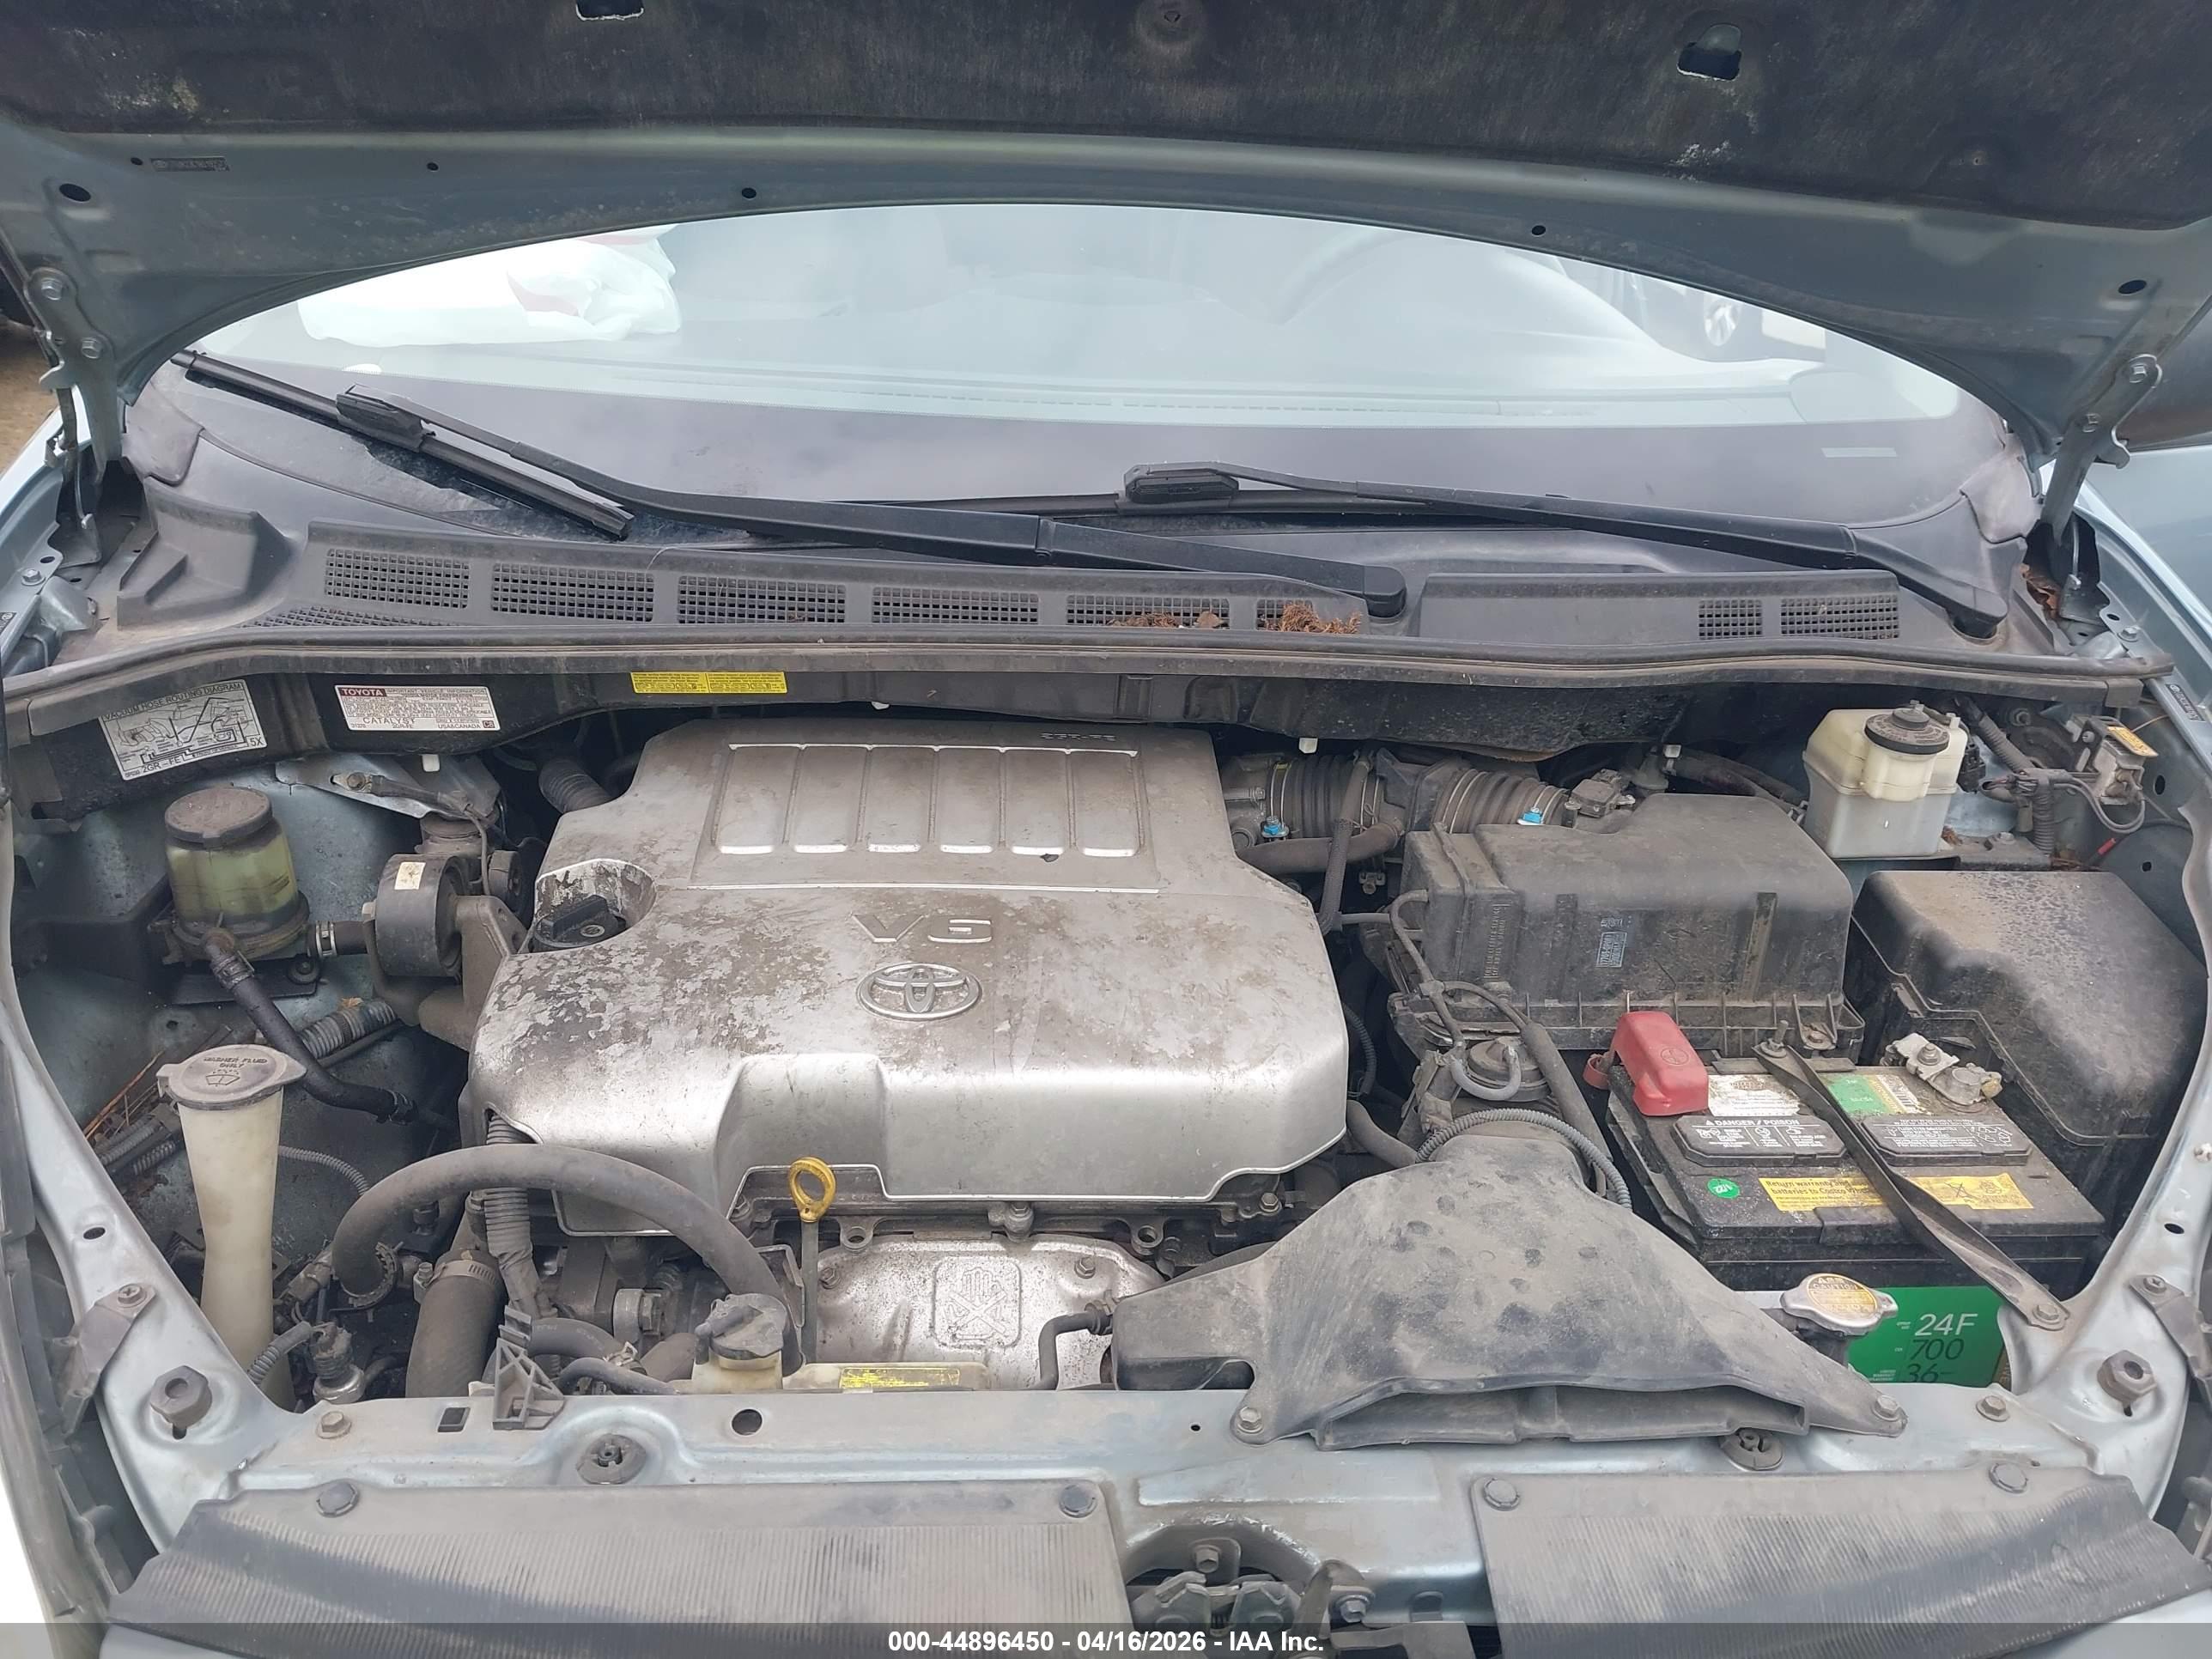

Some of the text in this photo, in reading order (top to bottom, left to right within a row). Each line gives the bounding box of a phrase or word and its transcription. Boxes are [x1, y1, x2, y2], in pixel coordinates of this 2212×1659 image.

[104, 683, 241, 720] VACUUM HOSE ROUTING DIAGRAM
[851, 914, 993, 943] V6
[1914, 1313, 1978, 1336] 24F
[1910, 1338, 1964, 1360] 700
[1905, 1363, 1940, 1383] 36
